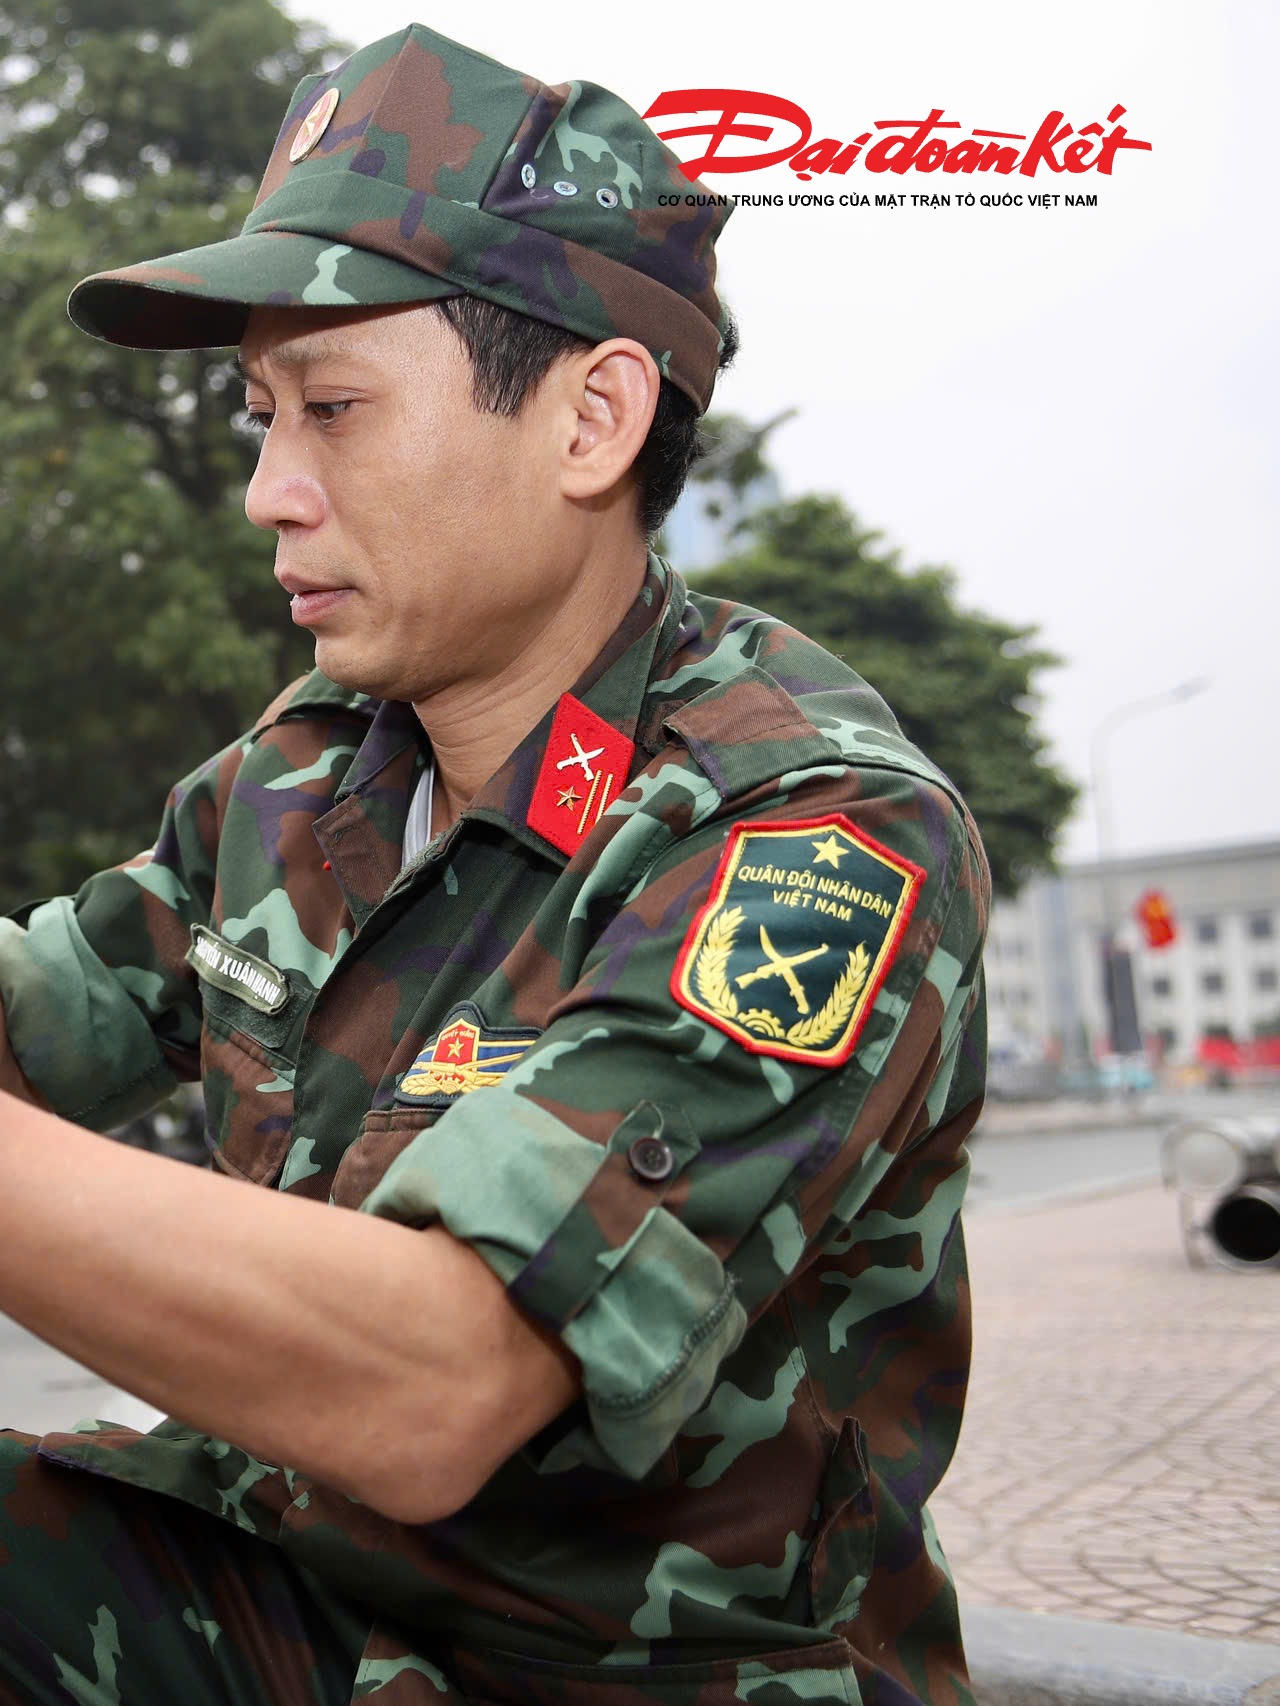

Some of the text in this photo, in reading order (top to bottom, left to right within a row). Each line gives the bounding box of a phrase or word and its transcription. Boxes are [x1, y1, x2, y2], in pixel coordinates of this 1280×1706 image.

[738, 864, 892, 919] QUÂN ĐỘI NHÂN DÂN
[772, 889, 853, 922] VIỆT NAM
